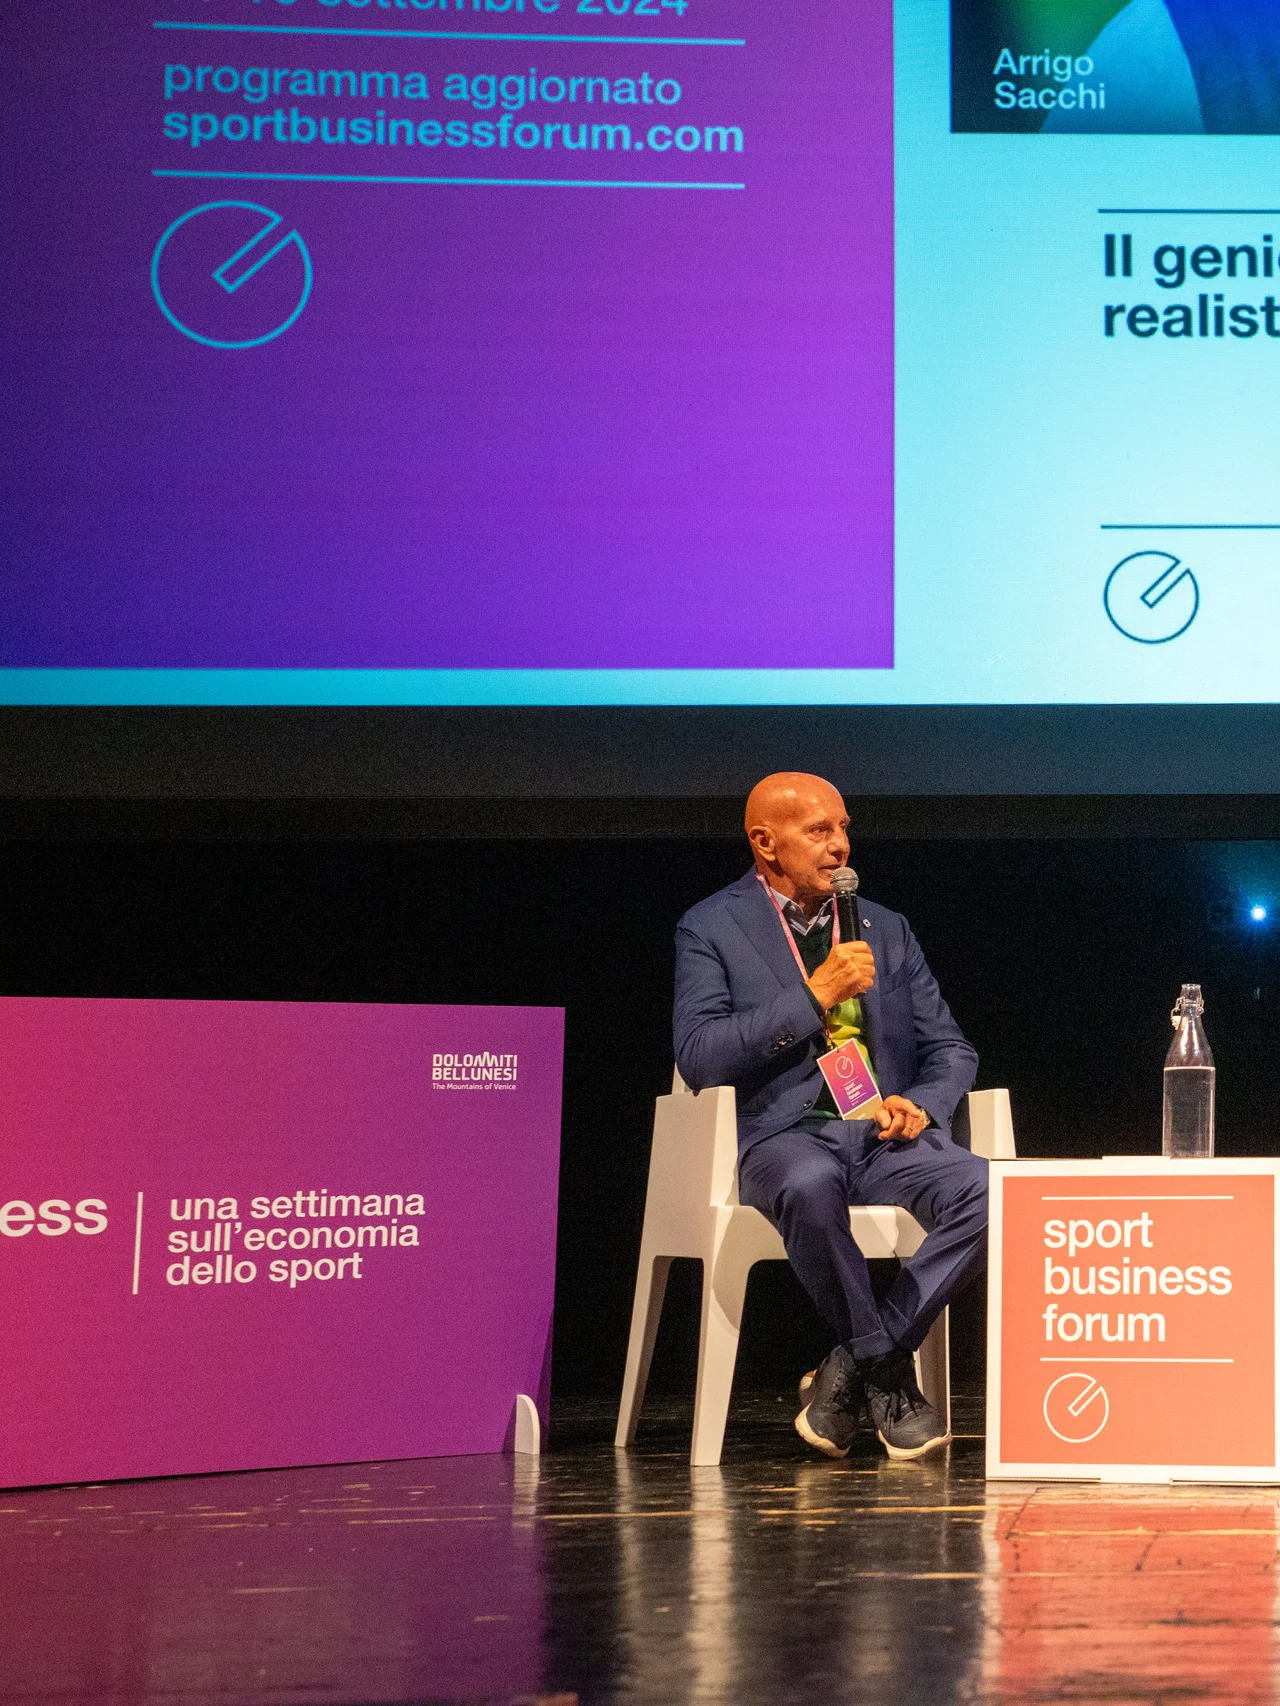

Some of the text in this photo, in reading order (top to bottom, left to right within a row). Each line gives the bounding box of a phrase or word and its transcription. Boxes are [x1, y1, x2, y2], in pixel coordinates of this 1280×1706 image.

[993, 48, 1094, 82] Arrigo
[164, 64, 682, 110] programma aggiornato
[995, 81, 1105, 109] Sacchi
[163, 107, 744, 152] sportbusinessforum.com
[1104, 234, 1132, 277] Il
[432, 1067, 517, 1081] BELLUNESI
[170, 1189, 426, 1221] una settimana
[1043, 1212, 1154, 1257] sport
[166, 1252, 363, 1288] dello sport
[1044, 1256, 1233, 1296] business
[1042, 1303, 1166, 1342] forum
